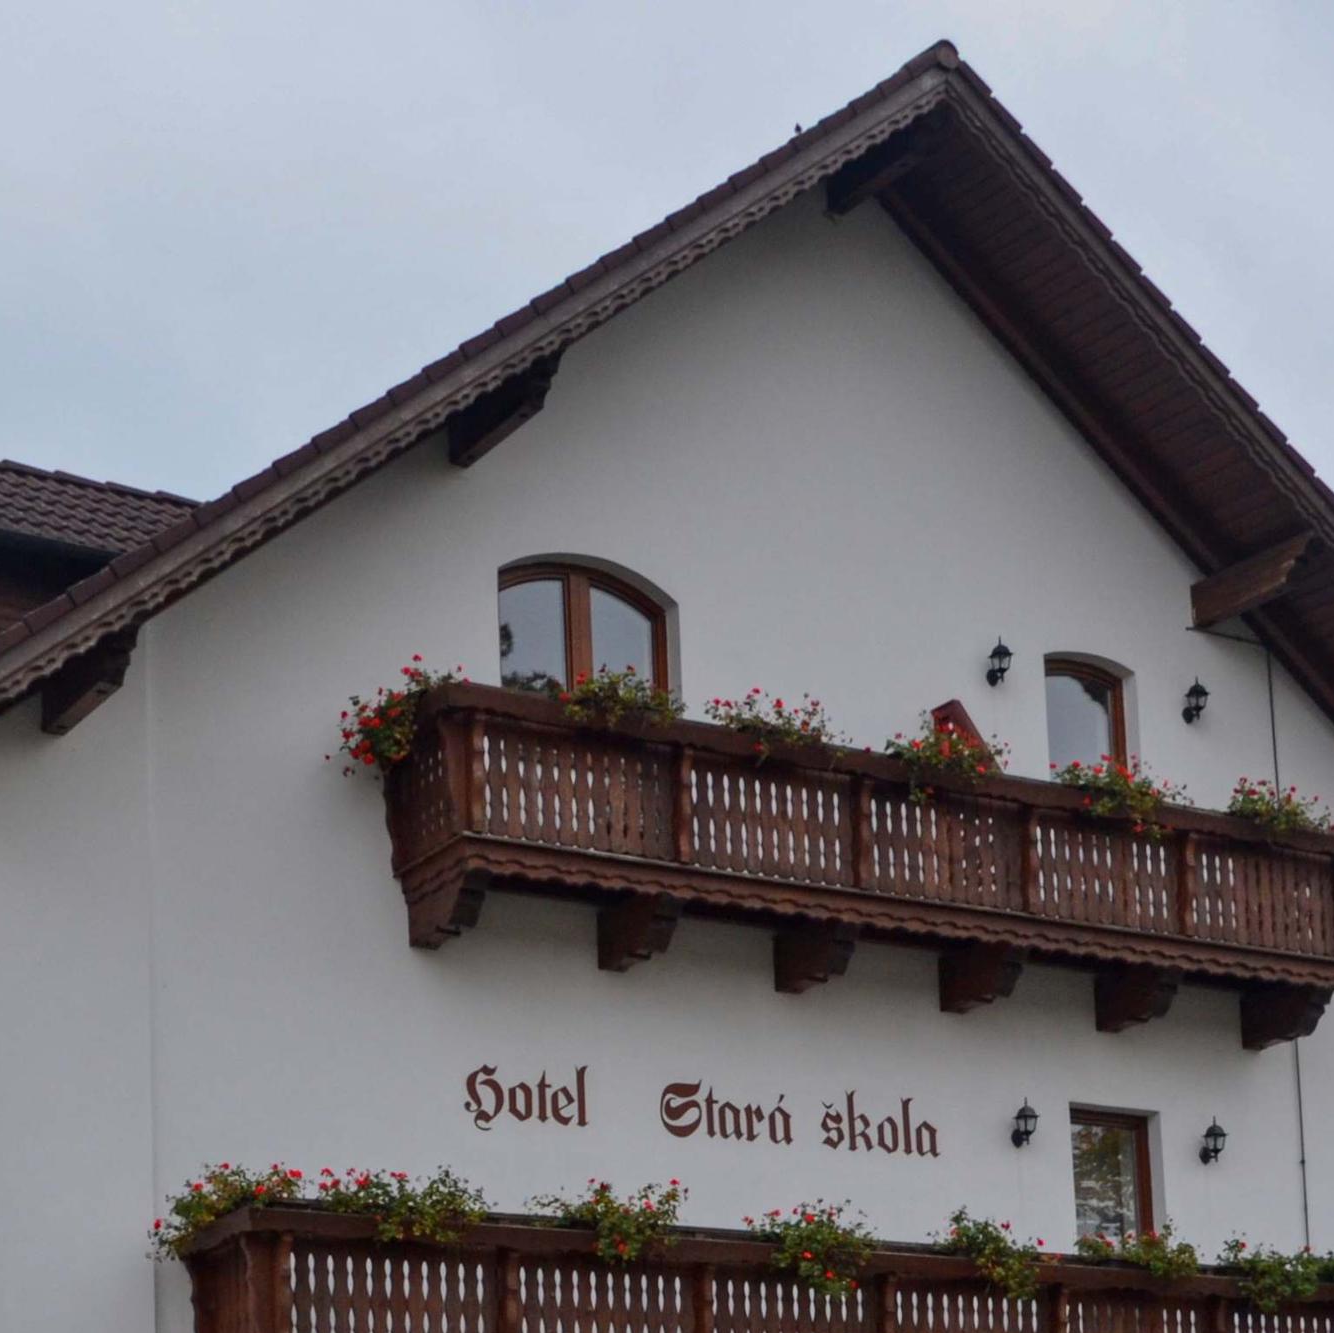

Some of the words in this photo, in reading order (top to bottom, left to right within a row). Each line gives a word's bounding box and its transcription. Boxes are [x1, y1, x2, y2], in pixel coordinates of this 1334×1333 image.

[464, 1064, 588, 1132] Hotel
[659, 1079, 794, 1146] Stará
[820, 1090, 941, 1159] škola
